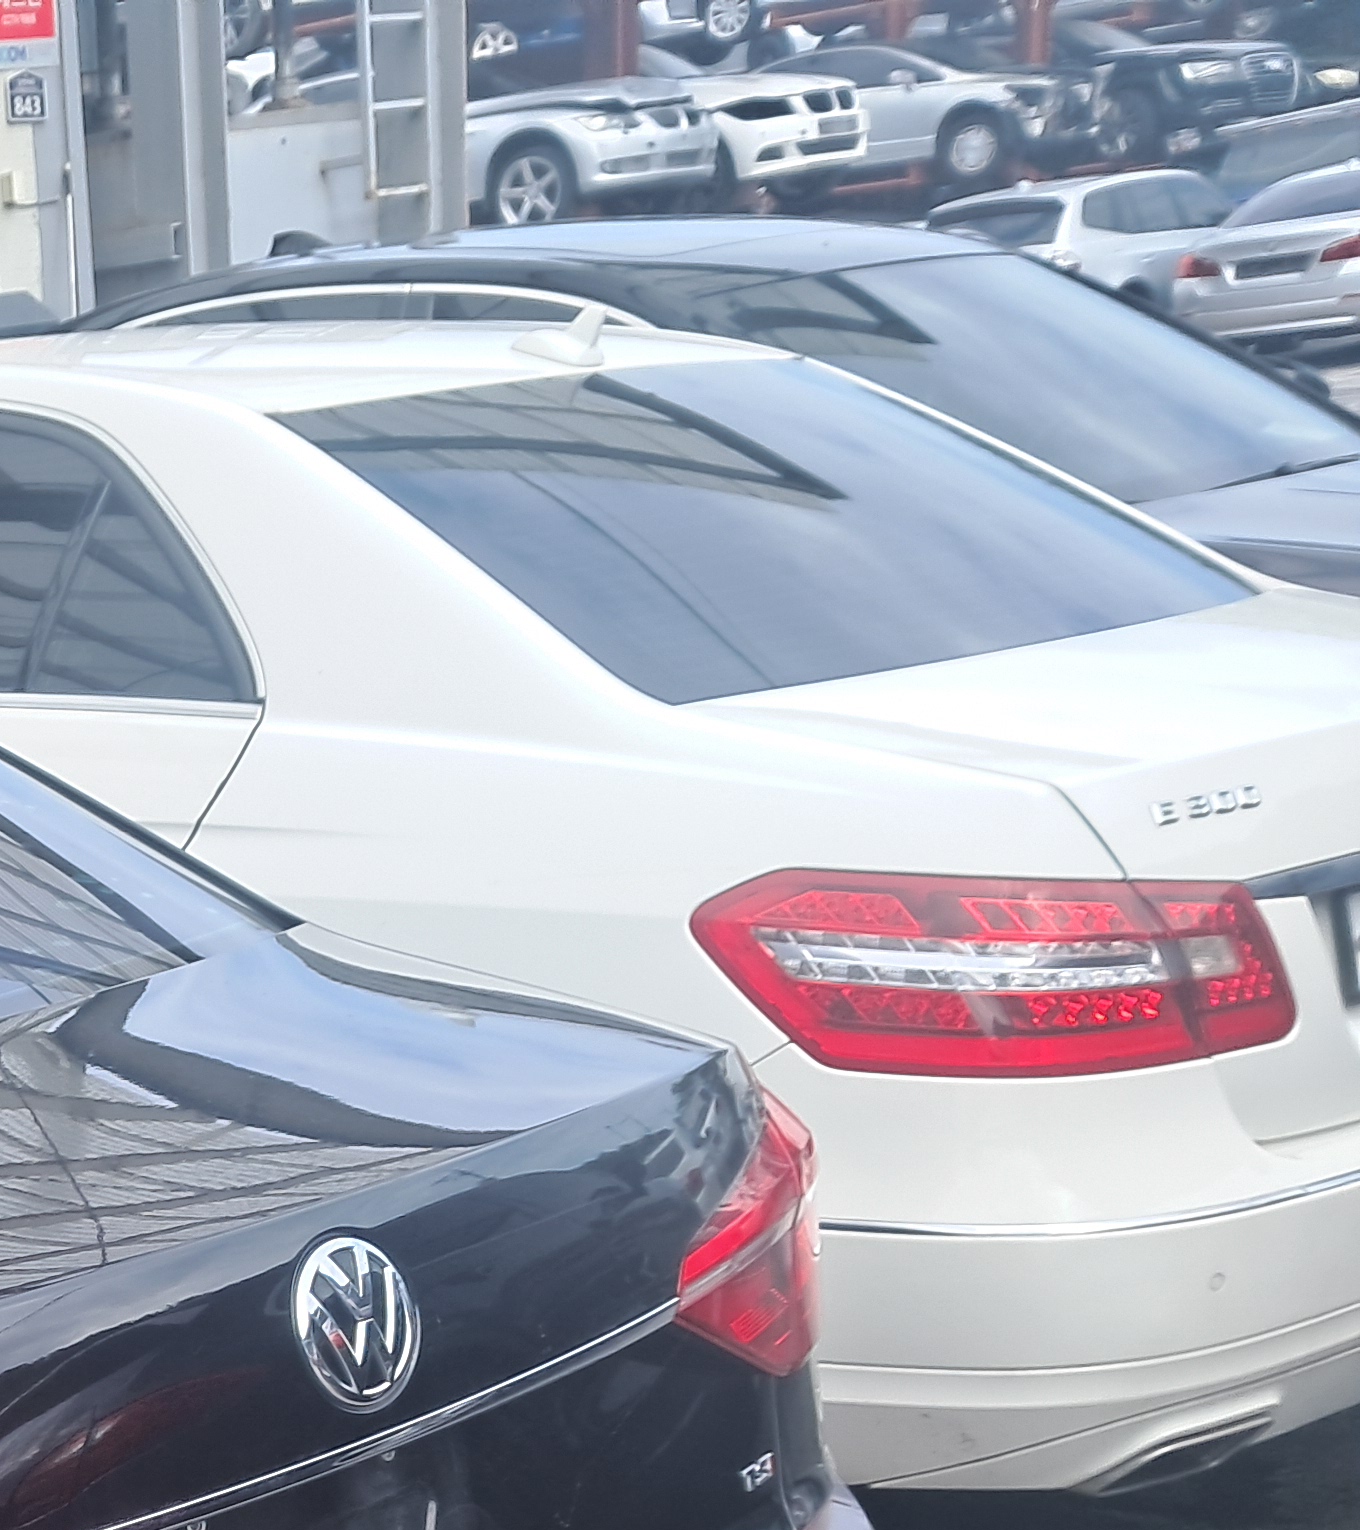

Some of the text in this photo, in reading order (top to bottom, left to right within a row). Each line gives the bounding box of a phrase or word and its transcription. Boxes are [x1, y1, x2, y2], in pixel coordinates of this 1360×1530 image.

[13, 94, 42, 116] 843
[1149, 784, 1262, 826] E 300
